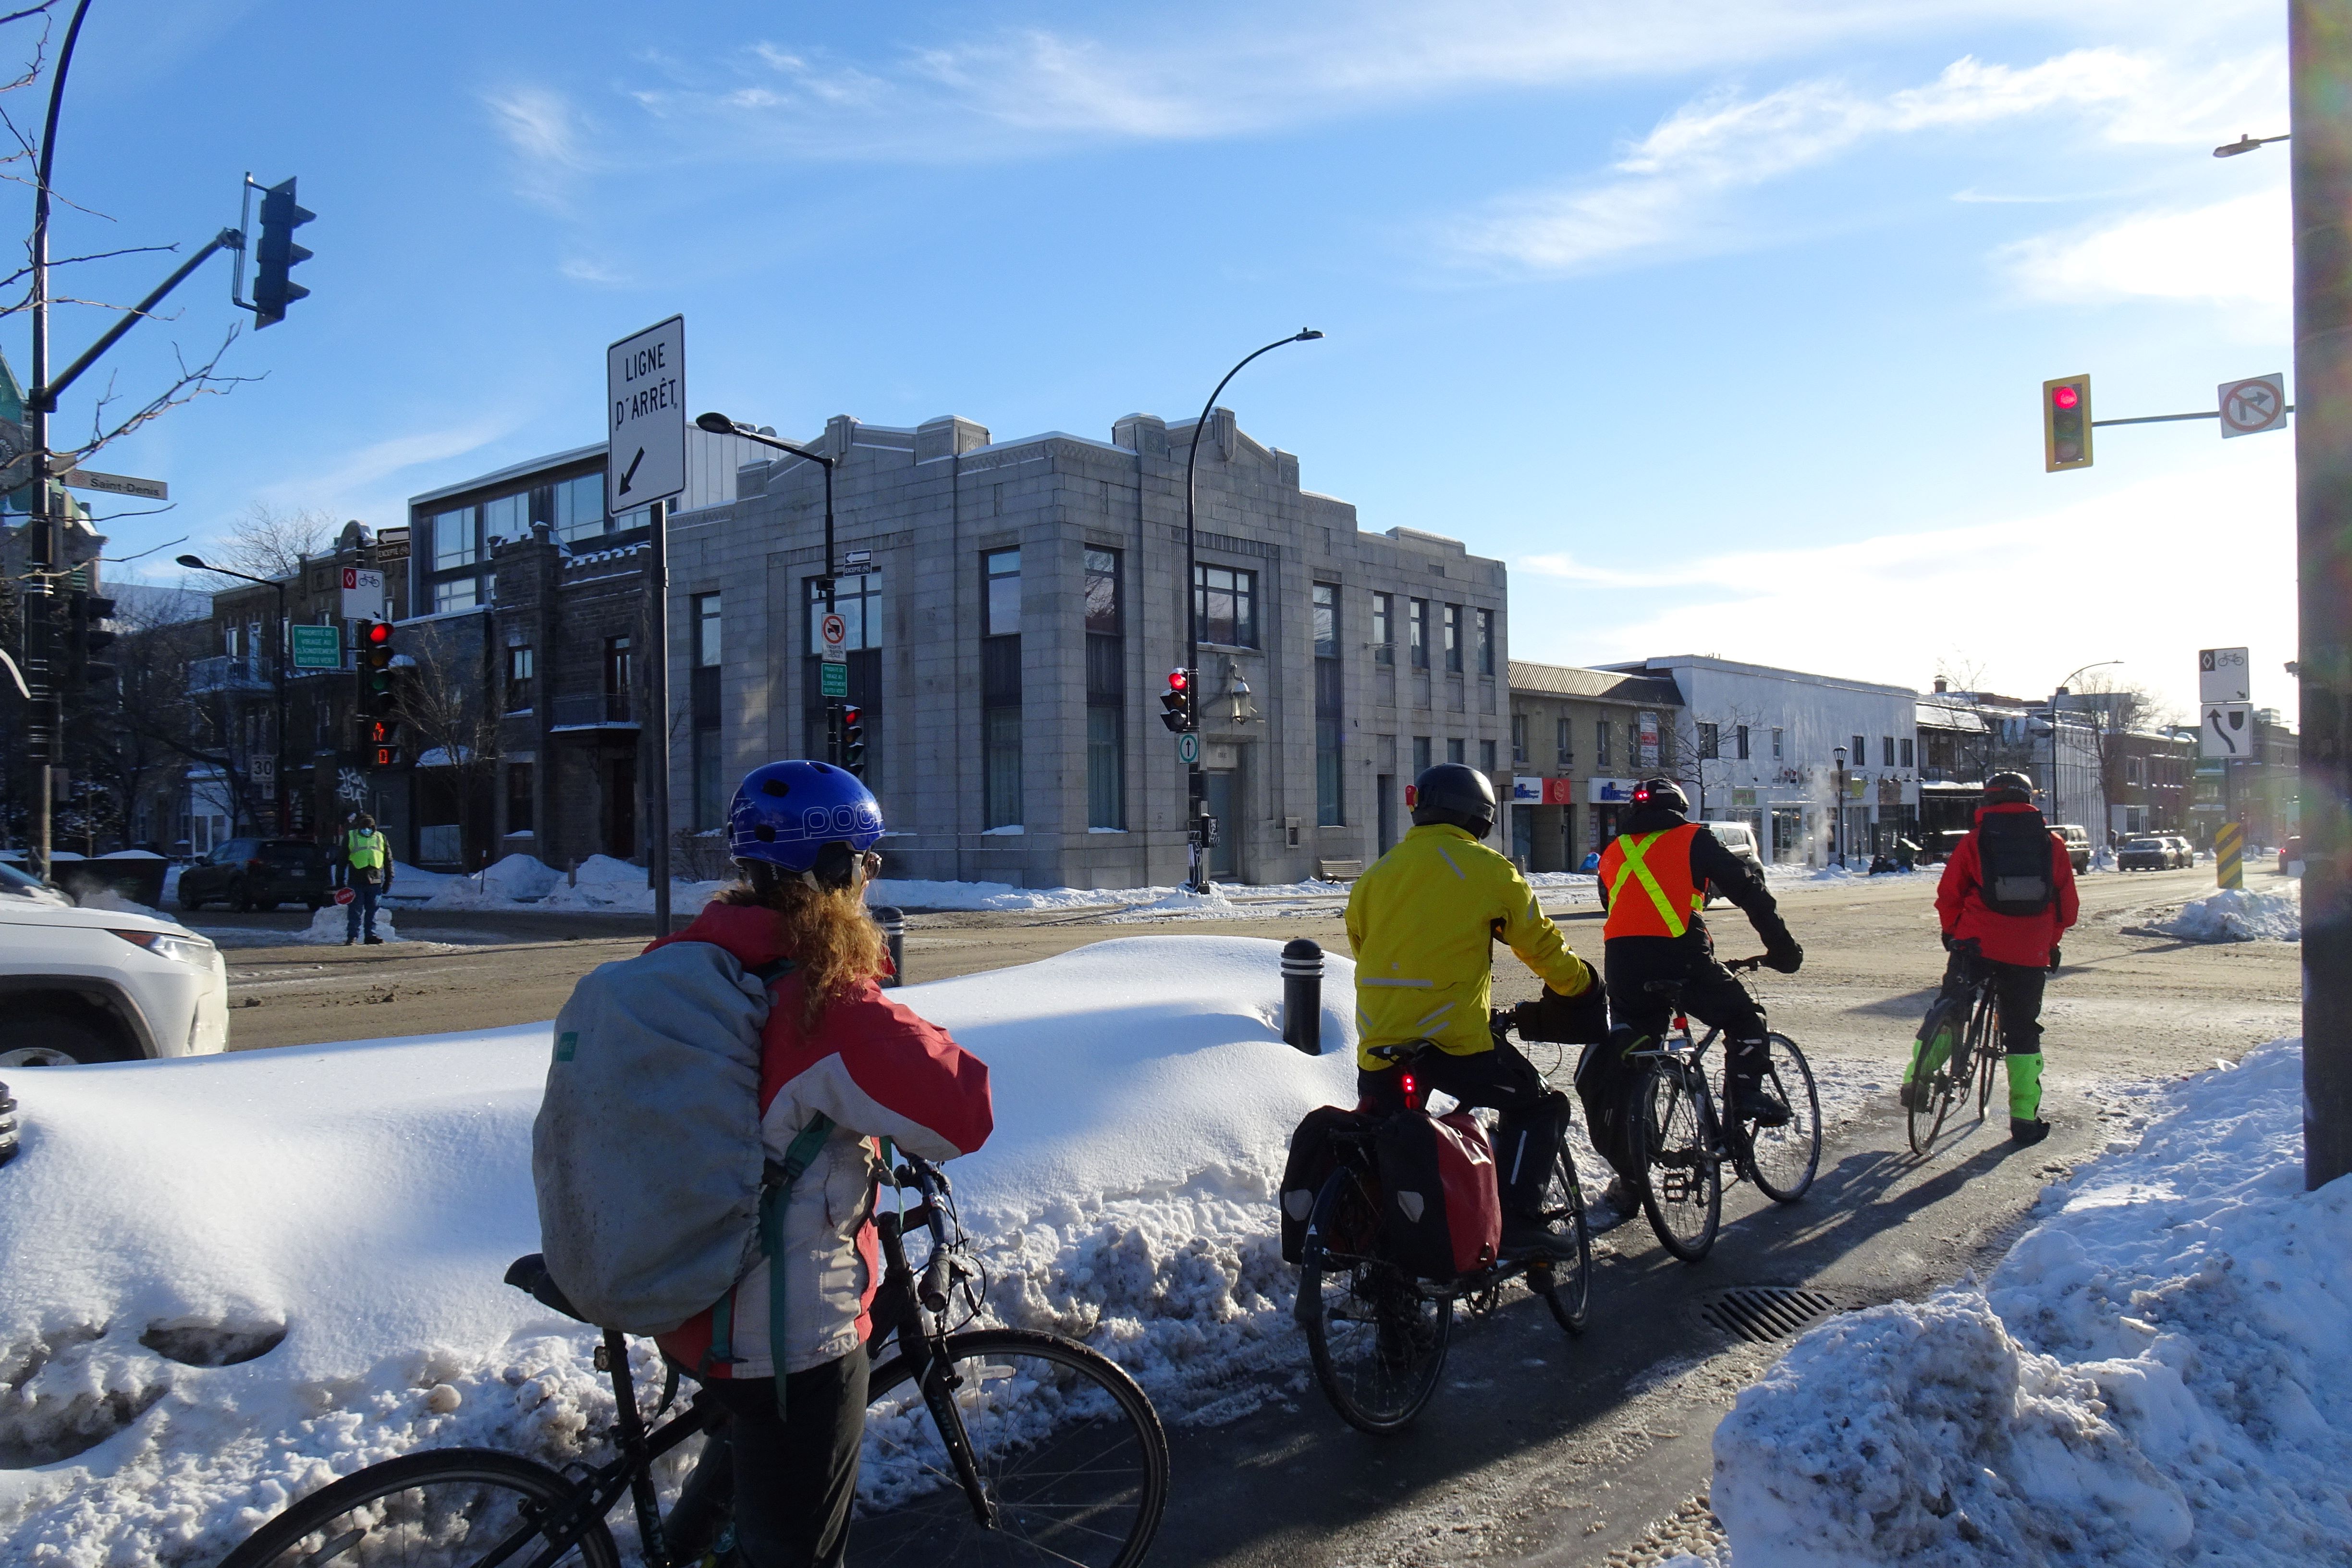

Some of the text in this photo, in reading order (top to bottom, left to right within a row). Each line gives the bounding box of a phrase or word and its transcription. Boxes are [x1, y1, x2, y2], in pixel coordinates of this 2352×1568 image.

[626, 343, 665, 382] LIGNE
[616, 378, 676, 426] D'ARRÊT
[90, 478, 159, 496] Saint-Denis
[254, 760, 272, 775] 30
